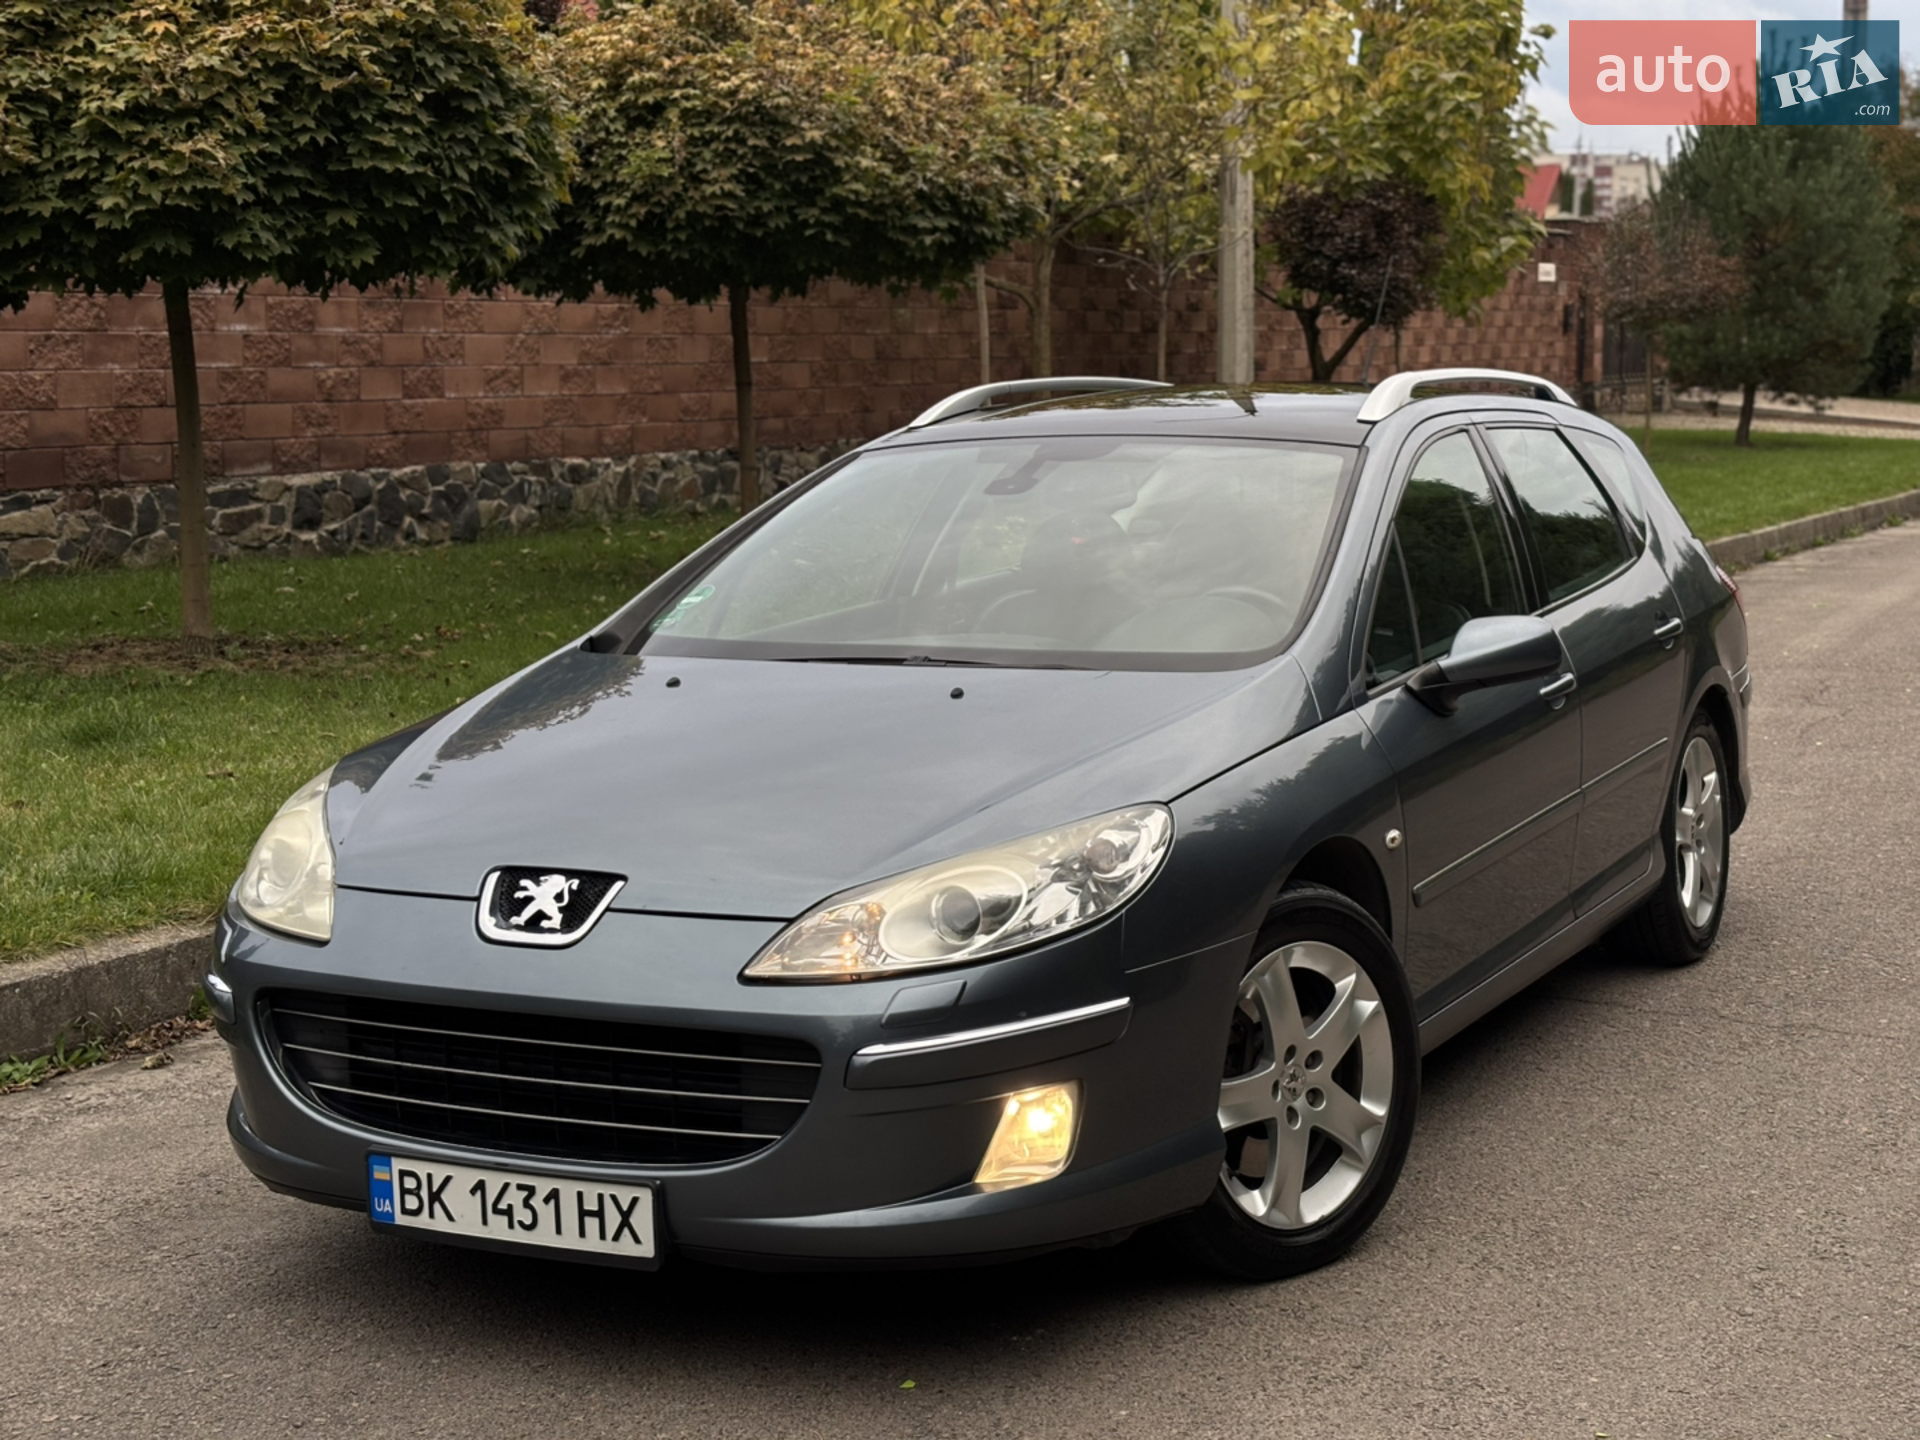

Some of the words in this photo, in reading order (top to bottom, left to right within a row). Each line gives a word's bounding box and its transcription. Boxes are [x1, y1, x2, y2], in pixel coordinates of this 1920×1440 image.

[374, 1197, 393, 1214] UA
[398, 1168, 457, 1223] BK
[469, 1178, 563, 1236] 1431
[576, 1190, 643, 1246] HX
